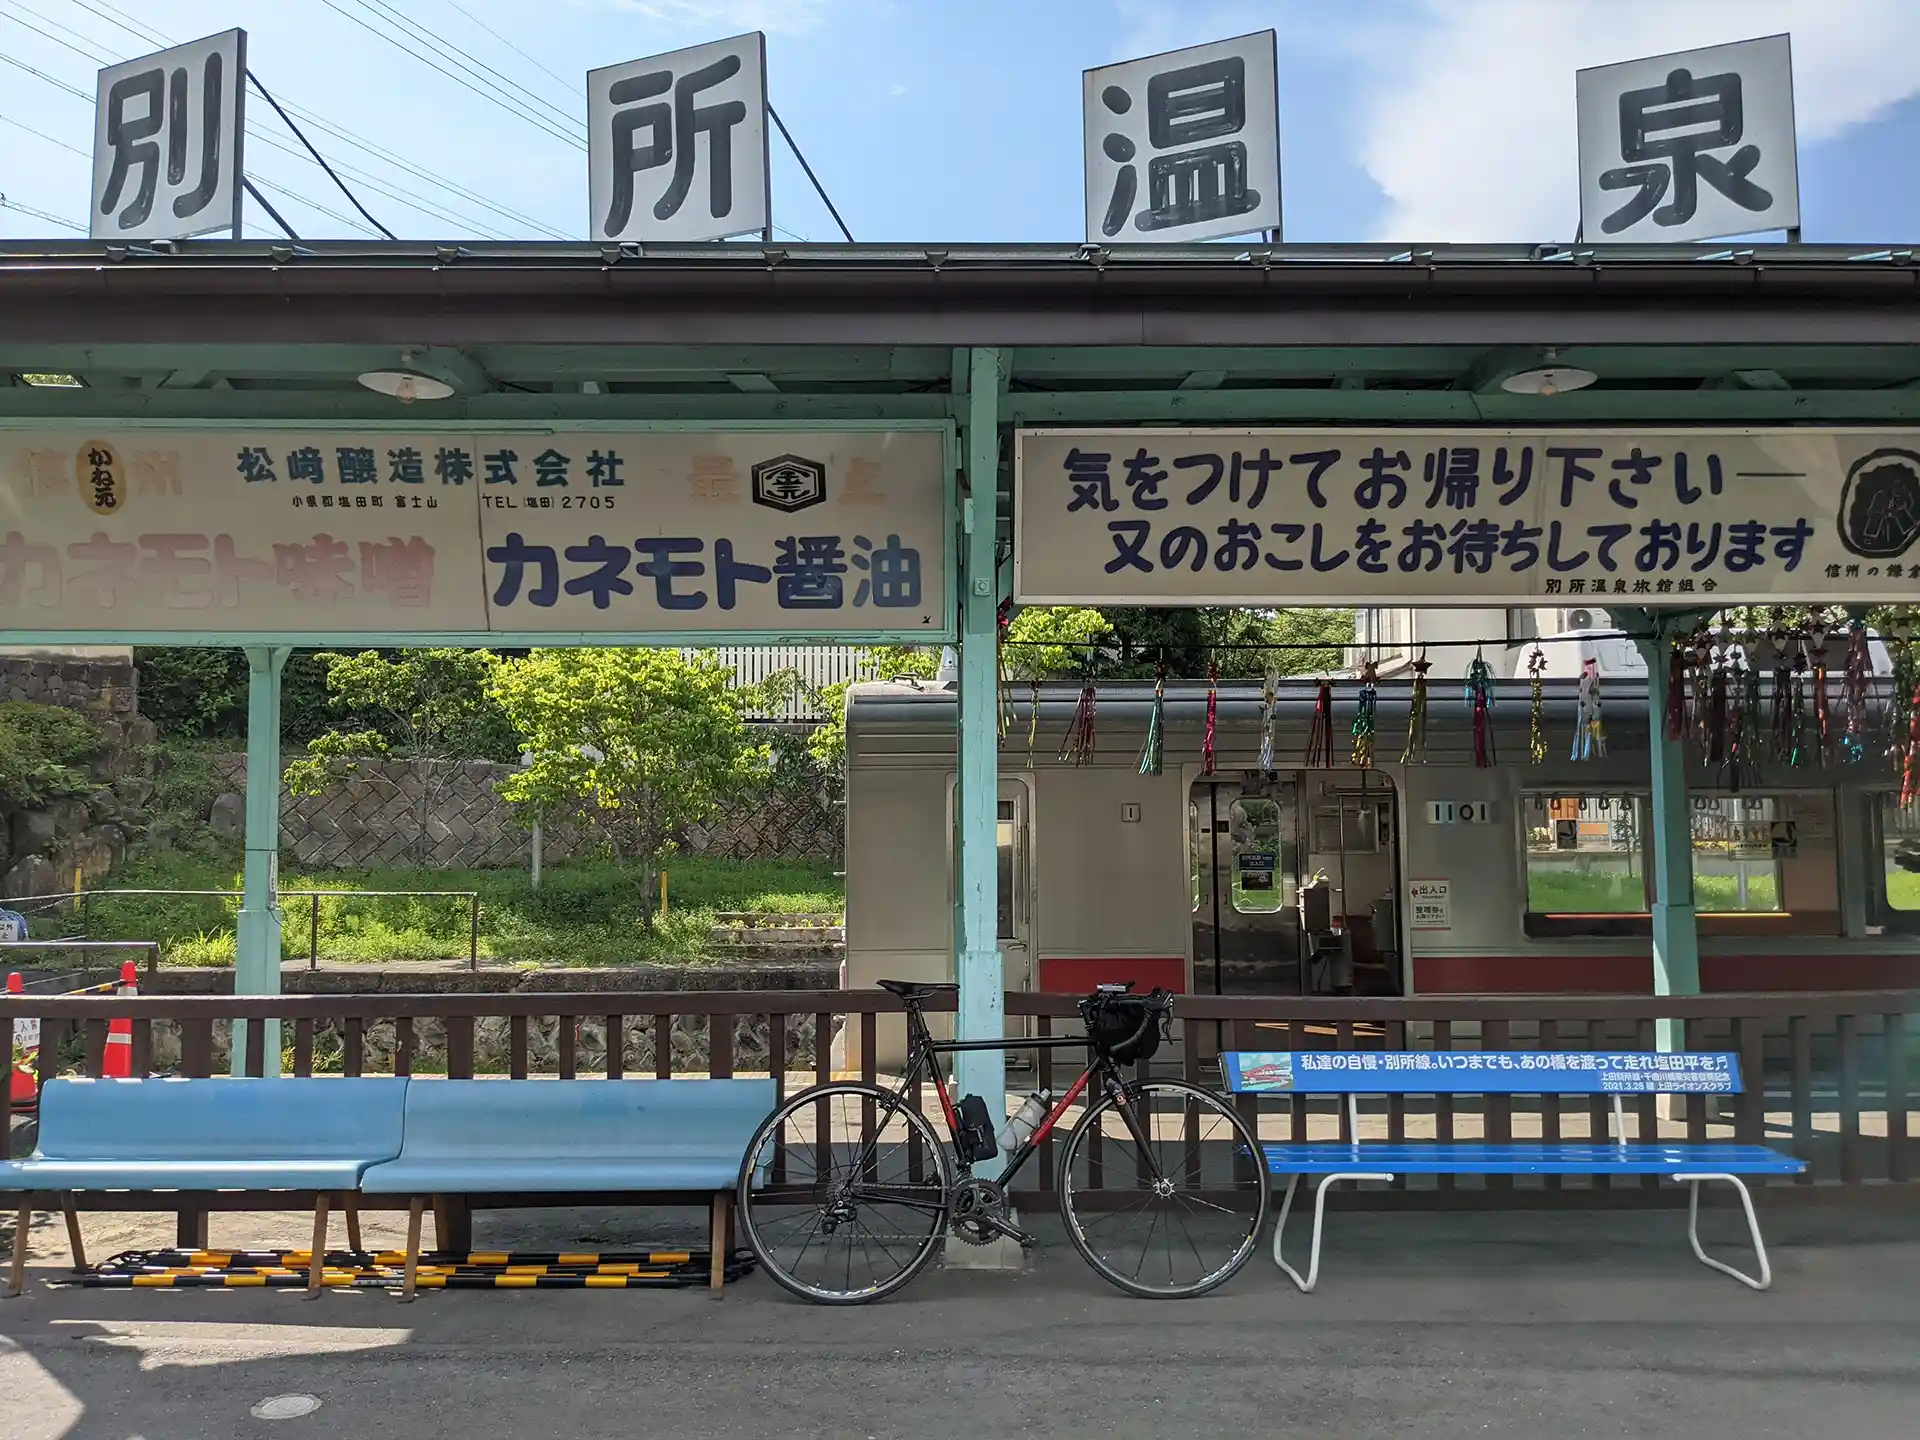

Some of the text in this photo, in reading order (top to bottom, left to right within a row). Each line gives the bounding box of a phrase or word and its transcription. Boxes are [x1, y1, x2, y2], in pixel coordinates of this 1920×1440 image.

[100, 51, 1773, 238] 別 所 温 泉
[482, 495, 518, 510] TEL
[561, 495, 616, 510] 2705
[1104, 517, 1815, 574] 又のおこしをお待ちしております
[486, 531, 923, 612] カネモト醤油
[1435, 804, 1486, 821] 1101
[1419, 885, 1447, 895] 出入口
